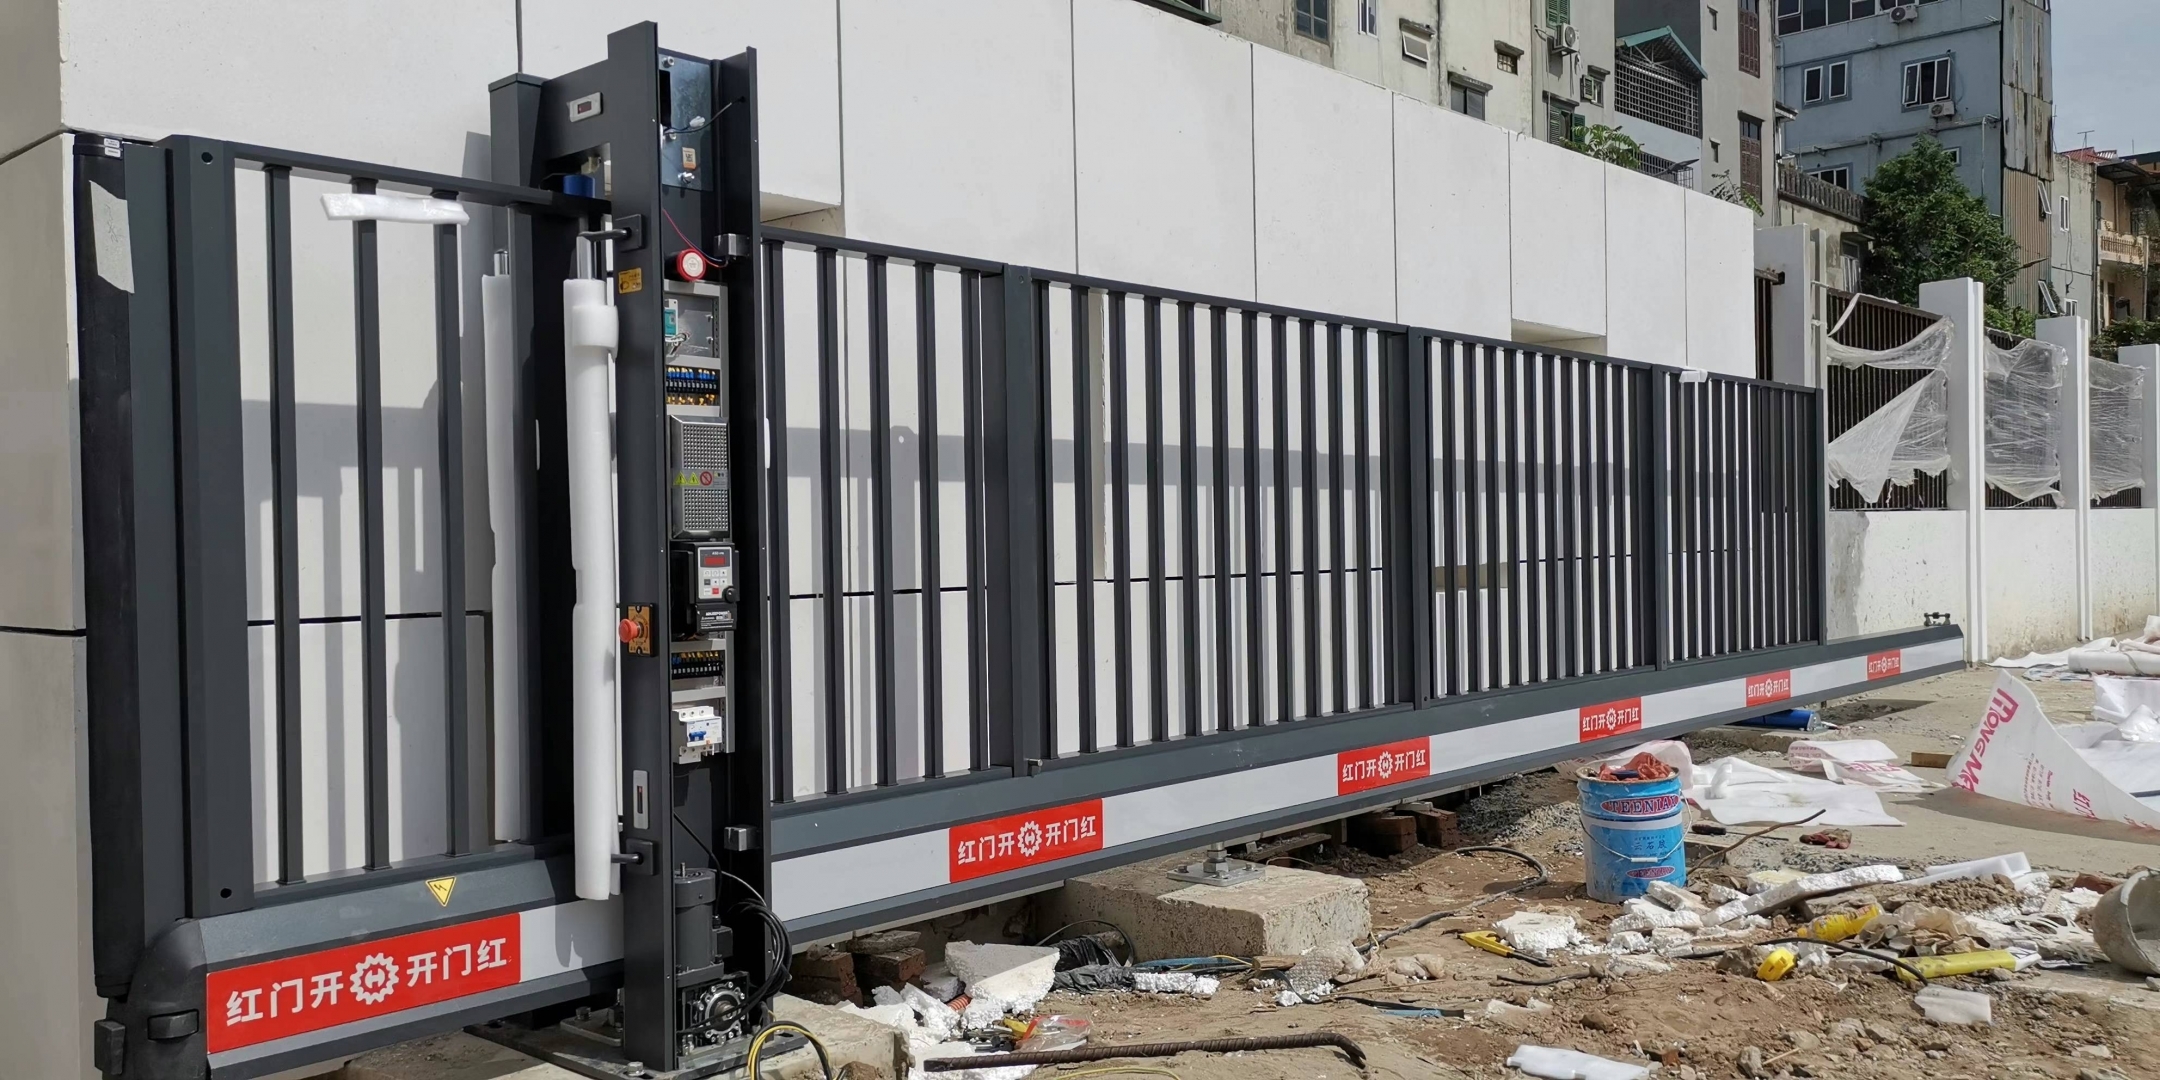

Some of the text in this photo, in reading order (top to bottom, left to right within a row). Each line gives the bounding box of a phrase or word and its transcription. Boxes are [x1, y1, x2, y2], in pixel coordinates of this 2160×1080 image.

[1582, 707, 1640, 732] 红门开 开门红
[1342, 758, 1377, 782] 红门开
[1394, 749, 1426, 772] 开门红
[957, 832, 1015, 866] 红门开
[1045, 815, 1097, 847] 开门红
[226, 970, 344, 1027] 红门开
[406, 937, 508, 988] 开门红
